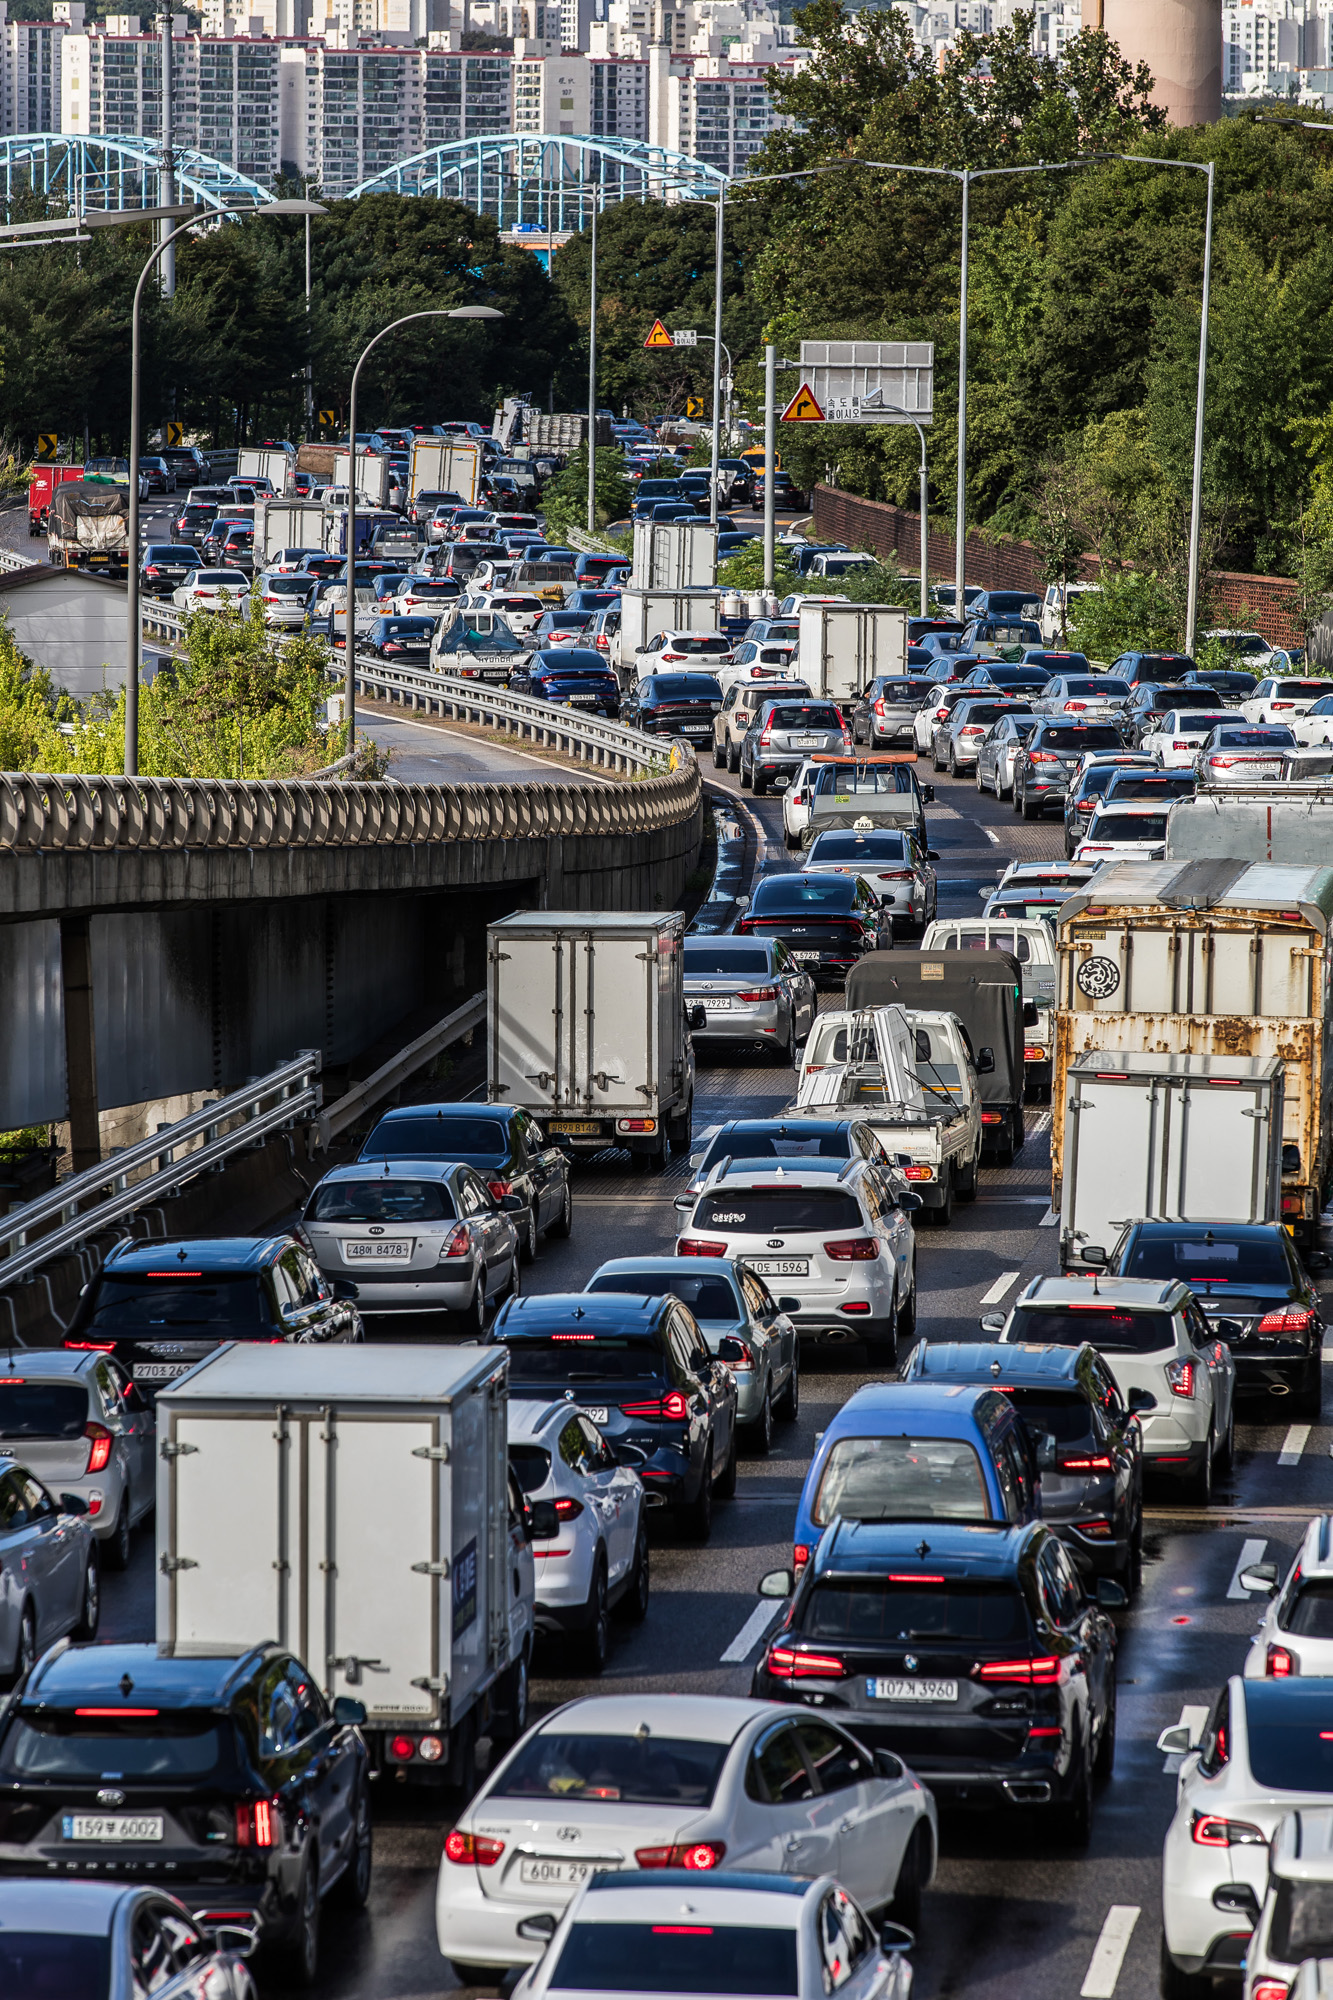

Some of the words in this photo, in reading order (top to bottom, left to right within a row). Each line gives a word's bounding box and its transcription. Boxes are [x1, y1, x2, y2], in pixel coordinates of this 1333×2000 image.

[828, 409, 859, 419] 줄이시오
[478, 655, 514, 663] HYUNDAI
[706, 999, 726, 1007] 7929
[575, 1123, 597, 1132] 8146
[352, 1245, 372, 1255] 48어
[376, 1245, 402, 1255] 8478
[751, 1262, 770, 1272] 10도
[776, 1262, 802, 1272] 1596
[137, 1365, 166, 1377] 270조
[880, 1679, 915, 1696] 107저
[919, 1680, 954, 1698] 3960
[120, 1819, 158, 1838] 6002
